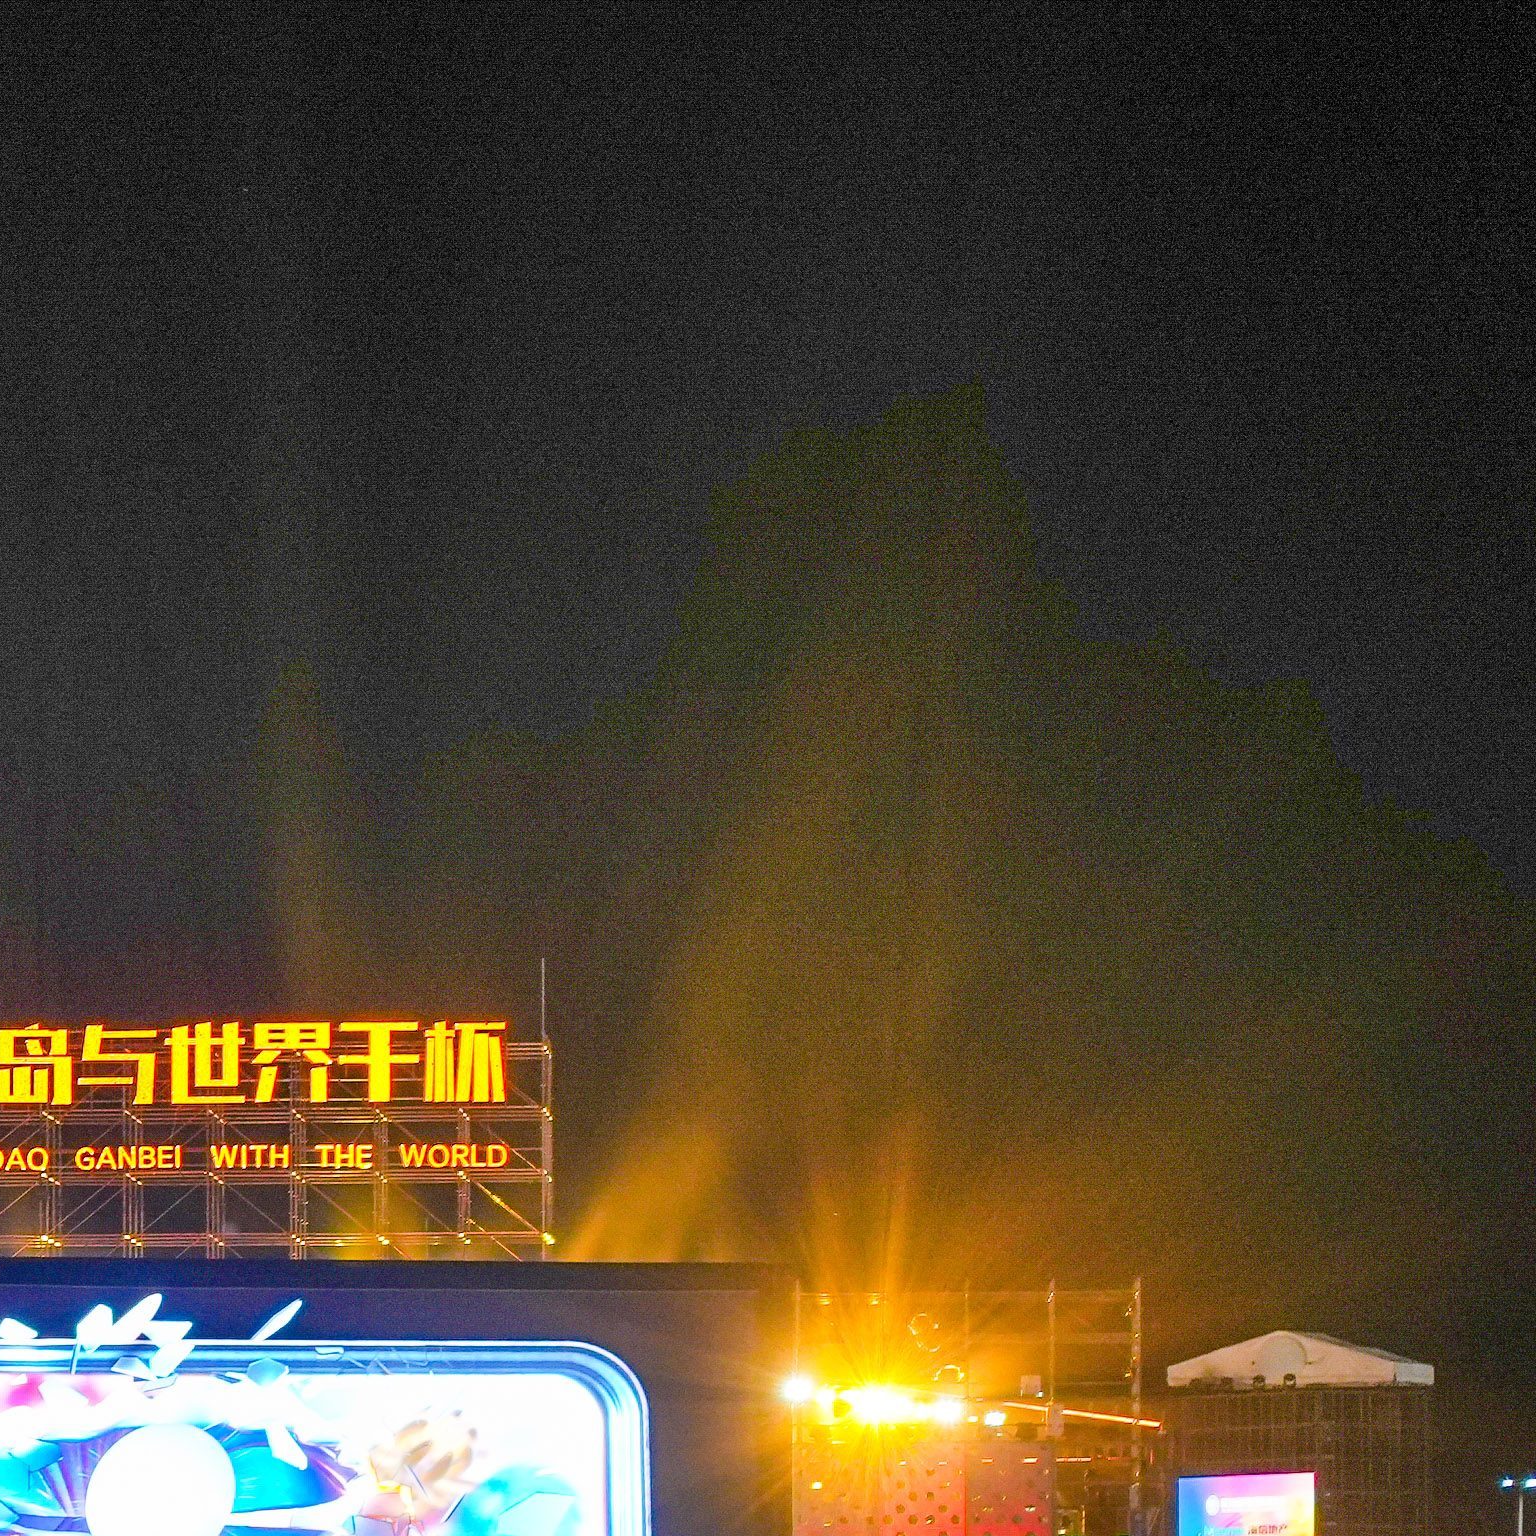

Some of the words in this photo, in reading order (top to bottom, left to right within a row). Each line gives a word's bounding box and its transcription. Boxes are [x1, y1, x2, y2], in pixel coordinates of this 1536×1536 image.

[74, 1145, 183, 1170] GANBEI
[209, 1144, 291, 1169] WITH
[314, 1144, 374, 1169] THE
[399, 1143, 509, 1168] WORLD
